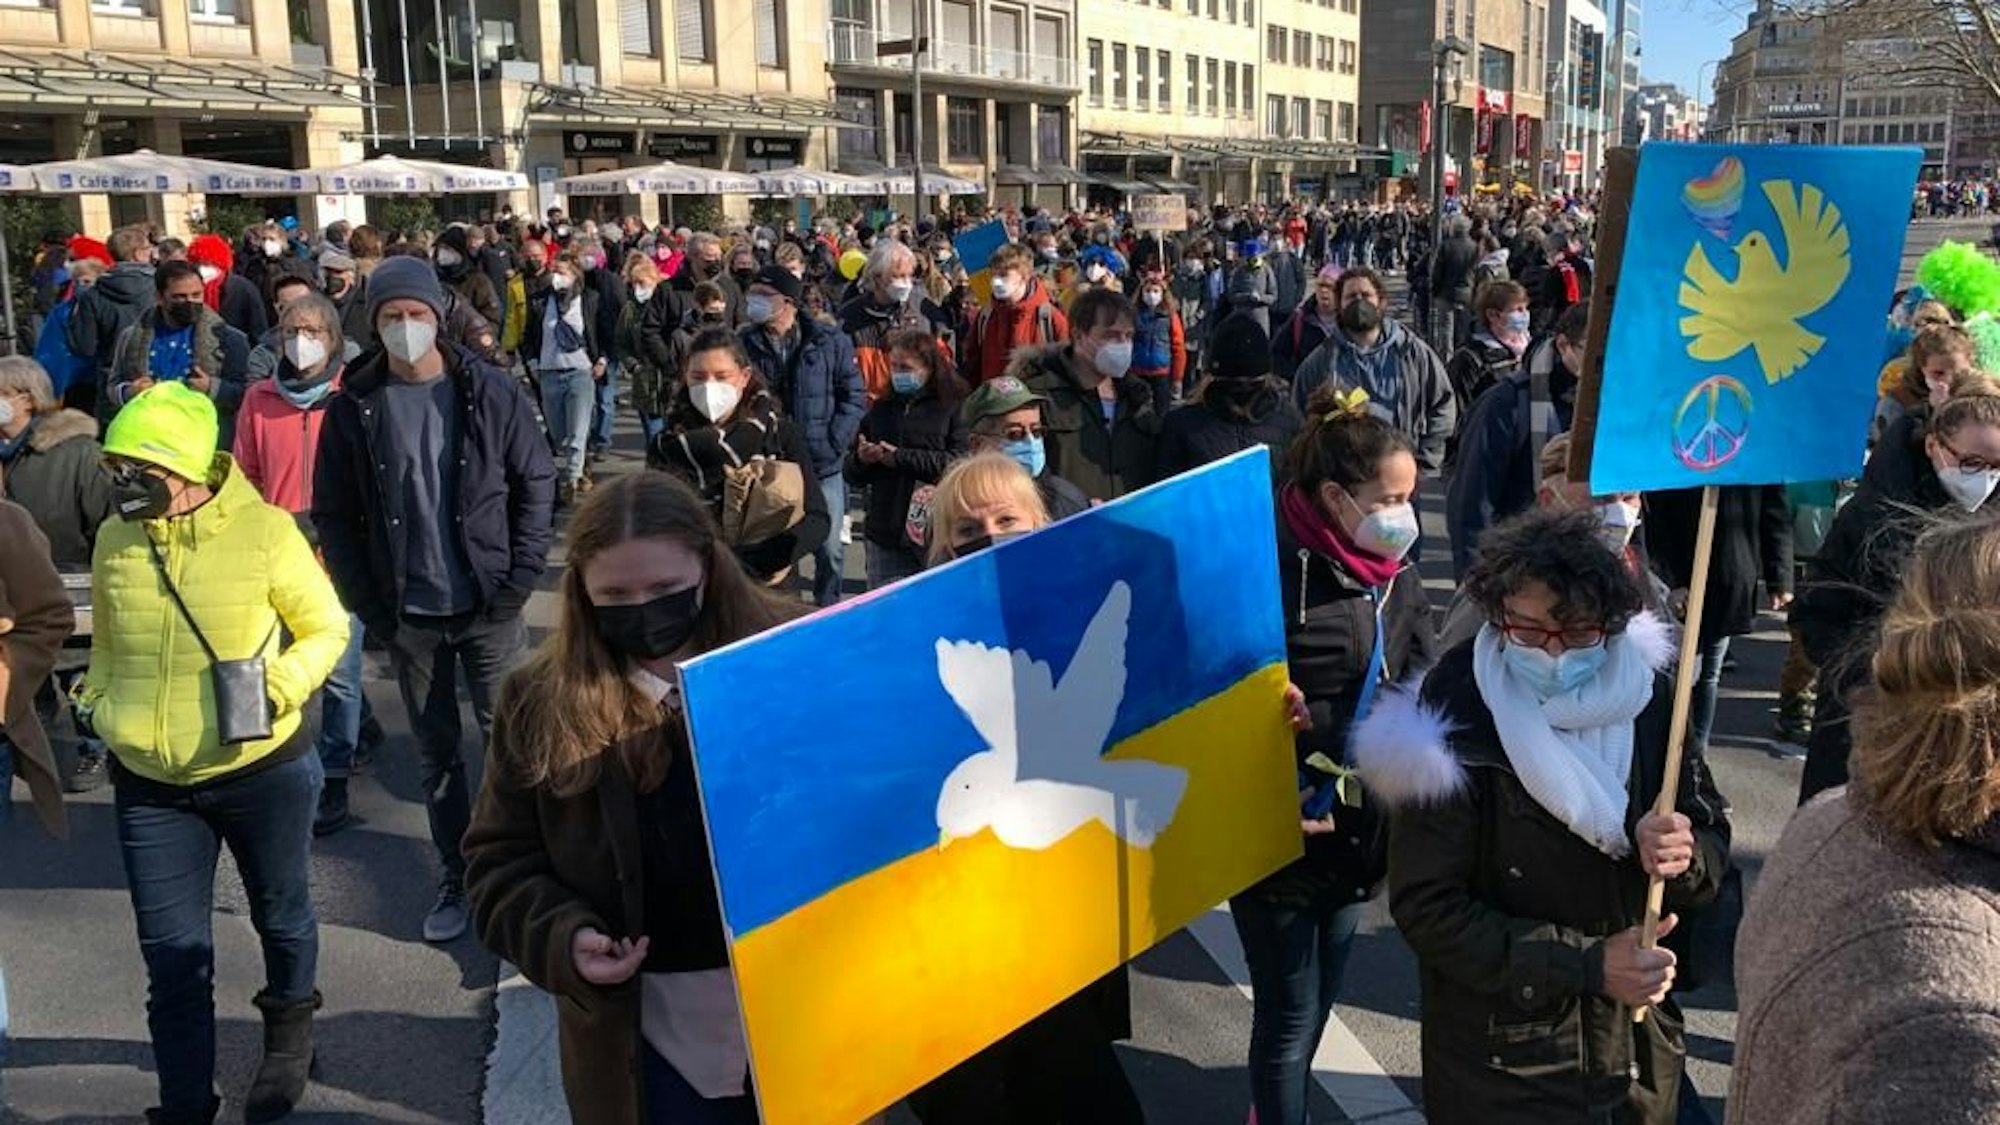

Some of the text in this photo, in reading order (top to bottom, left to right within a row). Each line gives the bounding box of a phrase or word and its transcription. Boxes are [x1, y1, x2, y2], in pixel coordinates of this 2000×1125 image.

[1769, 103, 1821, 112] FIVE GUYS
[79, 175, 148, 188] Café Riese
[226, 177, 251, 188] Café
[349, 178, 372, 188] Café
